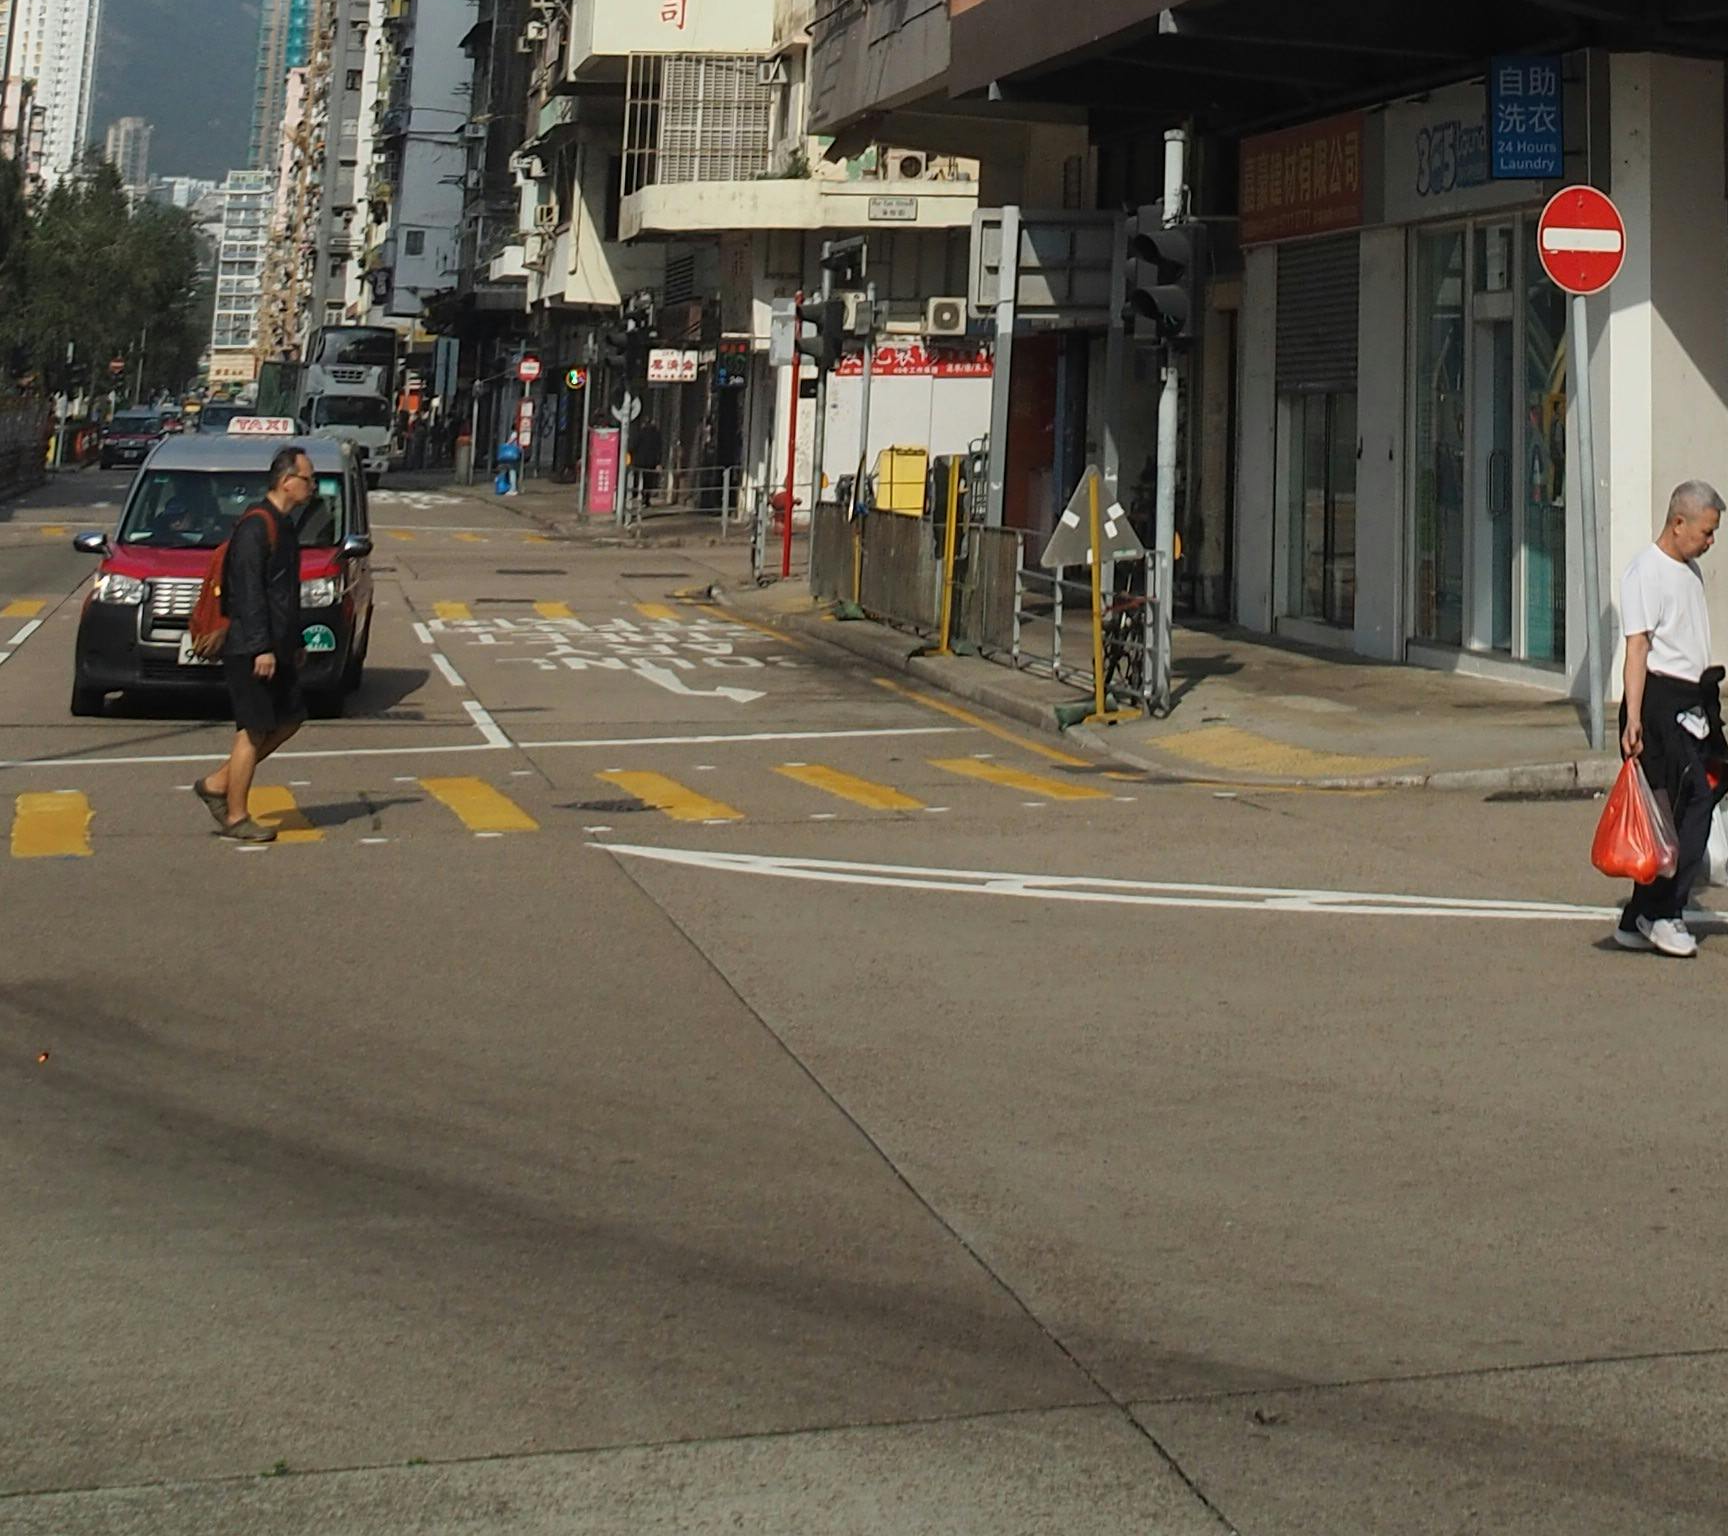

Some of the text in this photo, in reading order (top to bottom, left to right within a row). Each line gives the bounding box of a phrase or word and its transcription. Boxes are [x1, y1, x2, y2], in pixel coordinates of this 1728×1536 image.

[1500, 67, 1556, 96] 自助
[1498, 103, 1557, 133] 洗衣
[1498, 141, 1557, 153] 24 Hours
[1500, 157, 1555, 173] Laundry
[236, 419, 289, 432] TAXI
